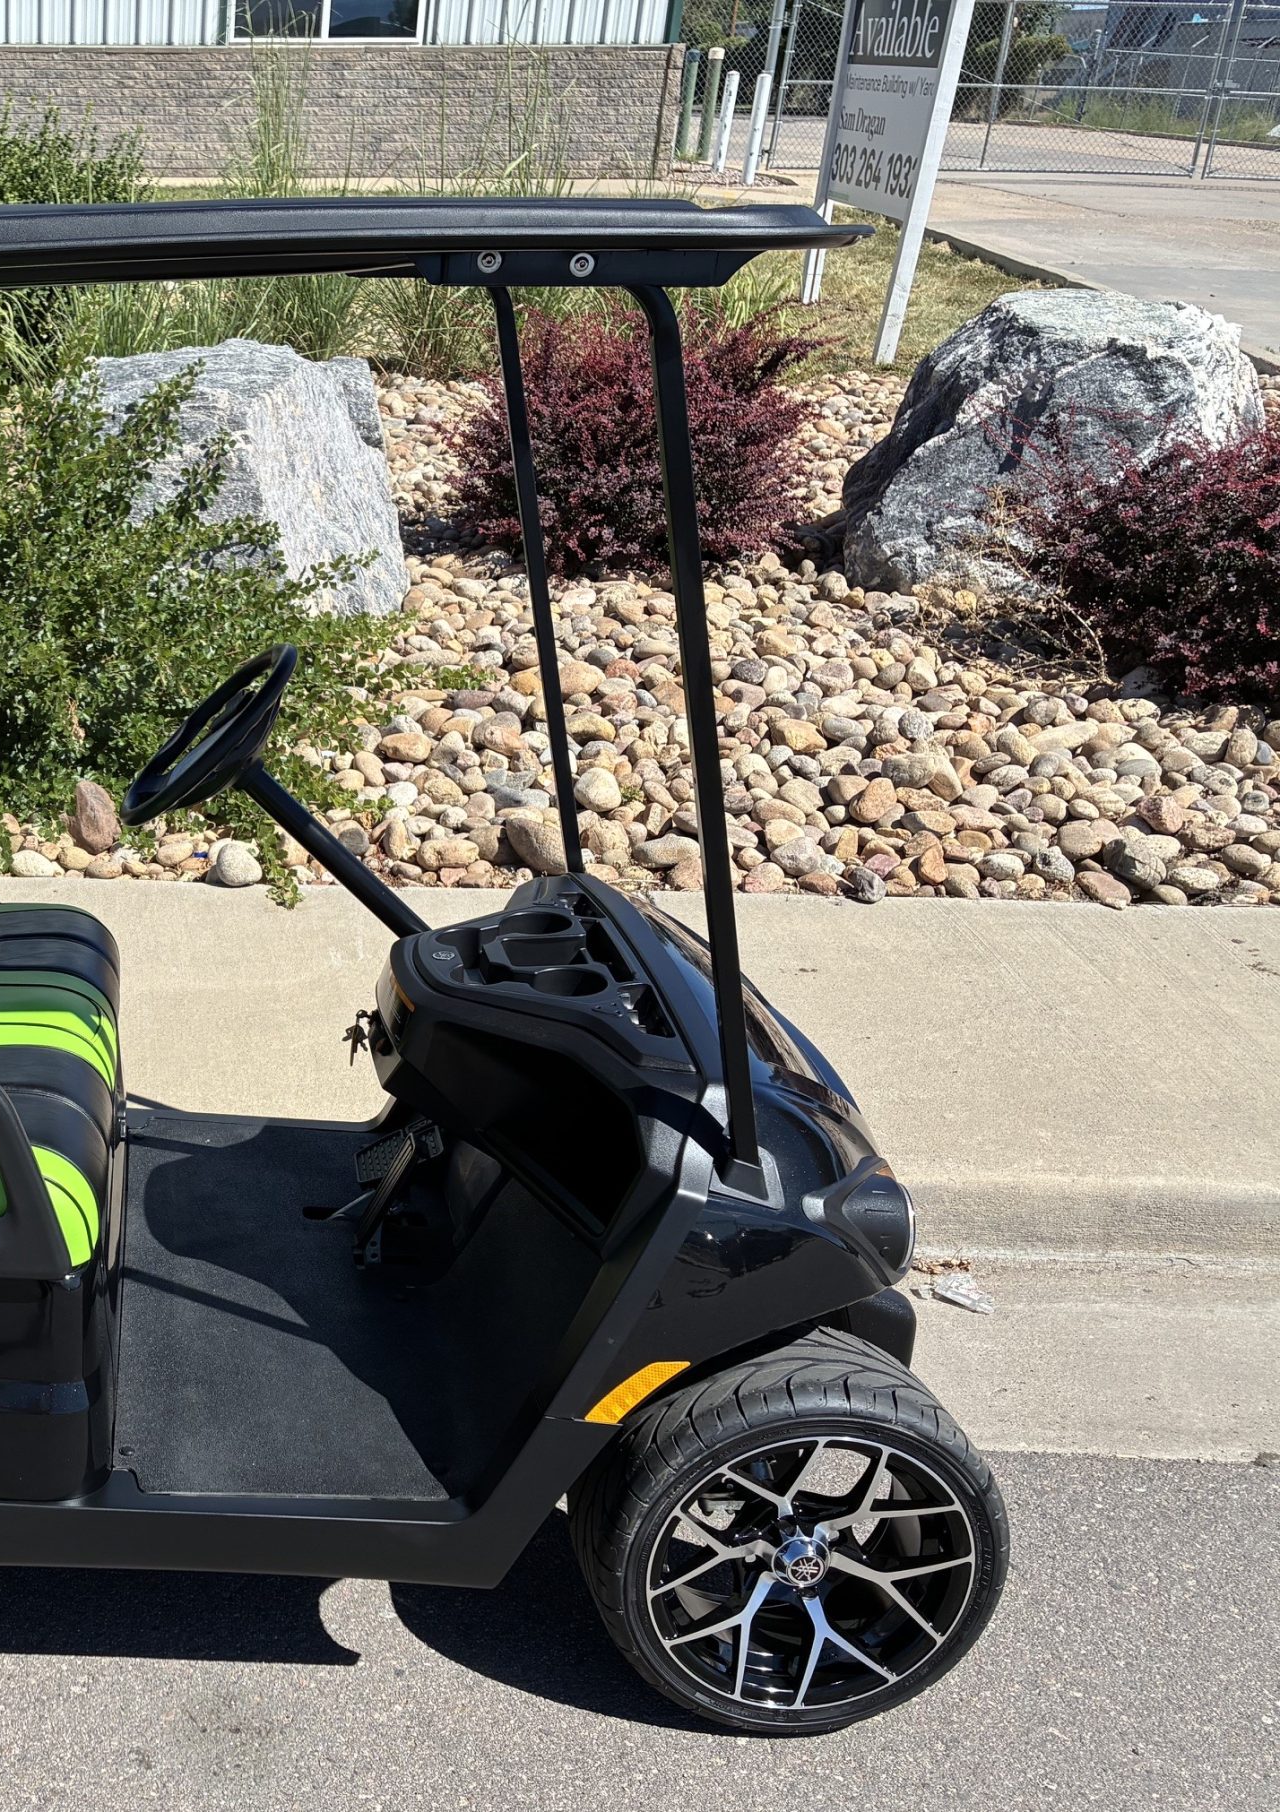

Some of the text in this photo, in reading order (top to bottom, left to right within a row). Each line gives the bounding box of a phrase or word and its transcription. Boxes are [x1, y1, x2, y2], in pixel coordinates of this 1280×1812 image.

[849, 0, 940, 59] Available
[881, 75, 909, 99] Building
[838, 105, 886, 141] Sam Dragan
[831, 142, 857, 185] 303
[855, 147, 884, 191] 264
